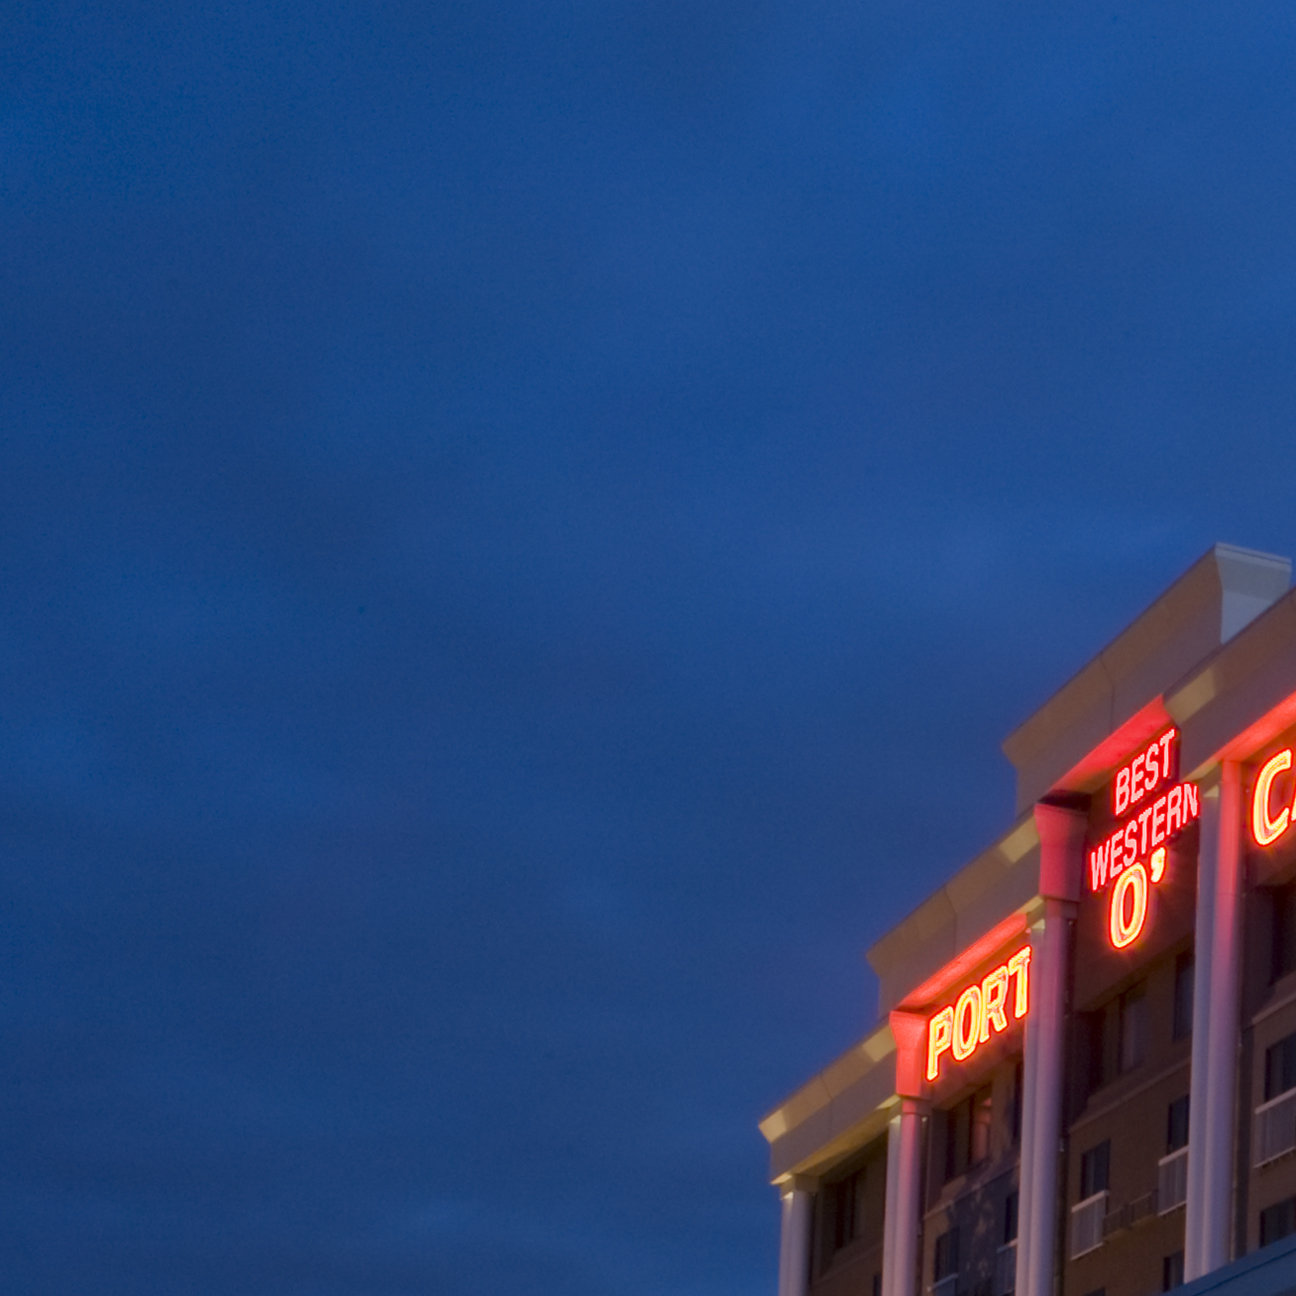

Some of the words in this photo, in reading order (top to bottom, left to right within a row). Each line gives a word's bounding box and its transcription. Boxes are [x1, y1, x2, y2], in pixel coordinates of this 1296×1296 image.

[1114, 727, 1175, 816] BEST
[1089, 781, 1200, 892] WESTERN
[925, 945, 1031, 1082] PORT
[1109, 846, 1167, 950] O'
